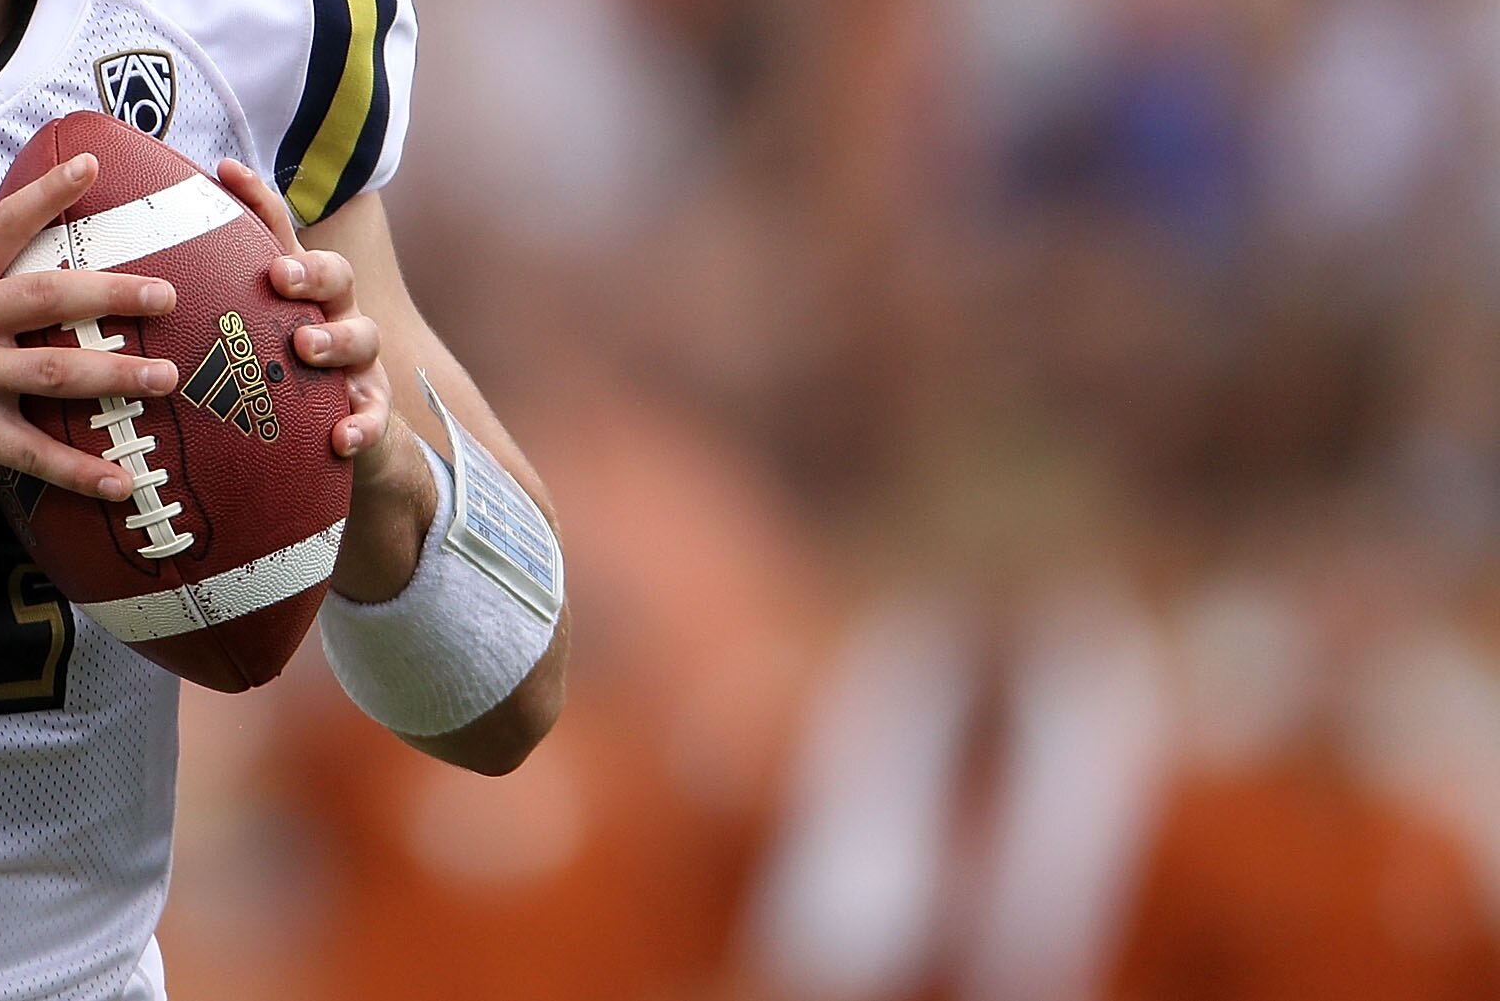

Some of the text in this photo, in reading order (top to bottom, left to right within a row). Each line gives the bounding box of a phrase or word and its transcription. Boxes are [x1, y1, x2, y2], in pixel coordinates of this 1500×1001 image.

[100, 54, 171, 118] PAC
[123, 99, 163, 136] 10
[219, 311, 280, 443] adidas
